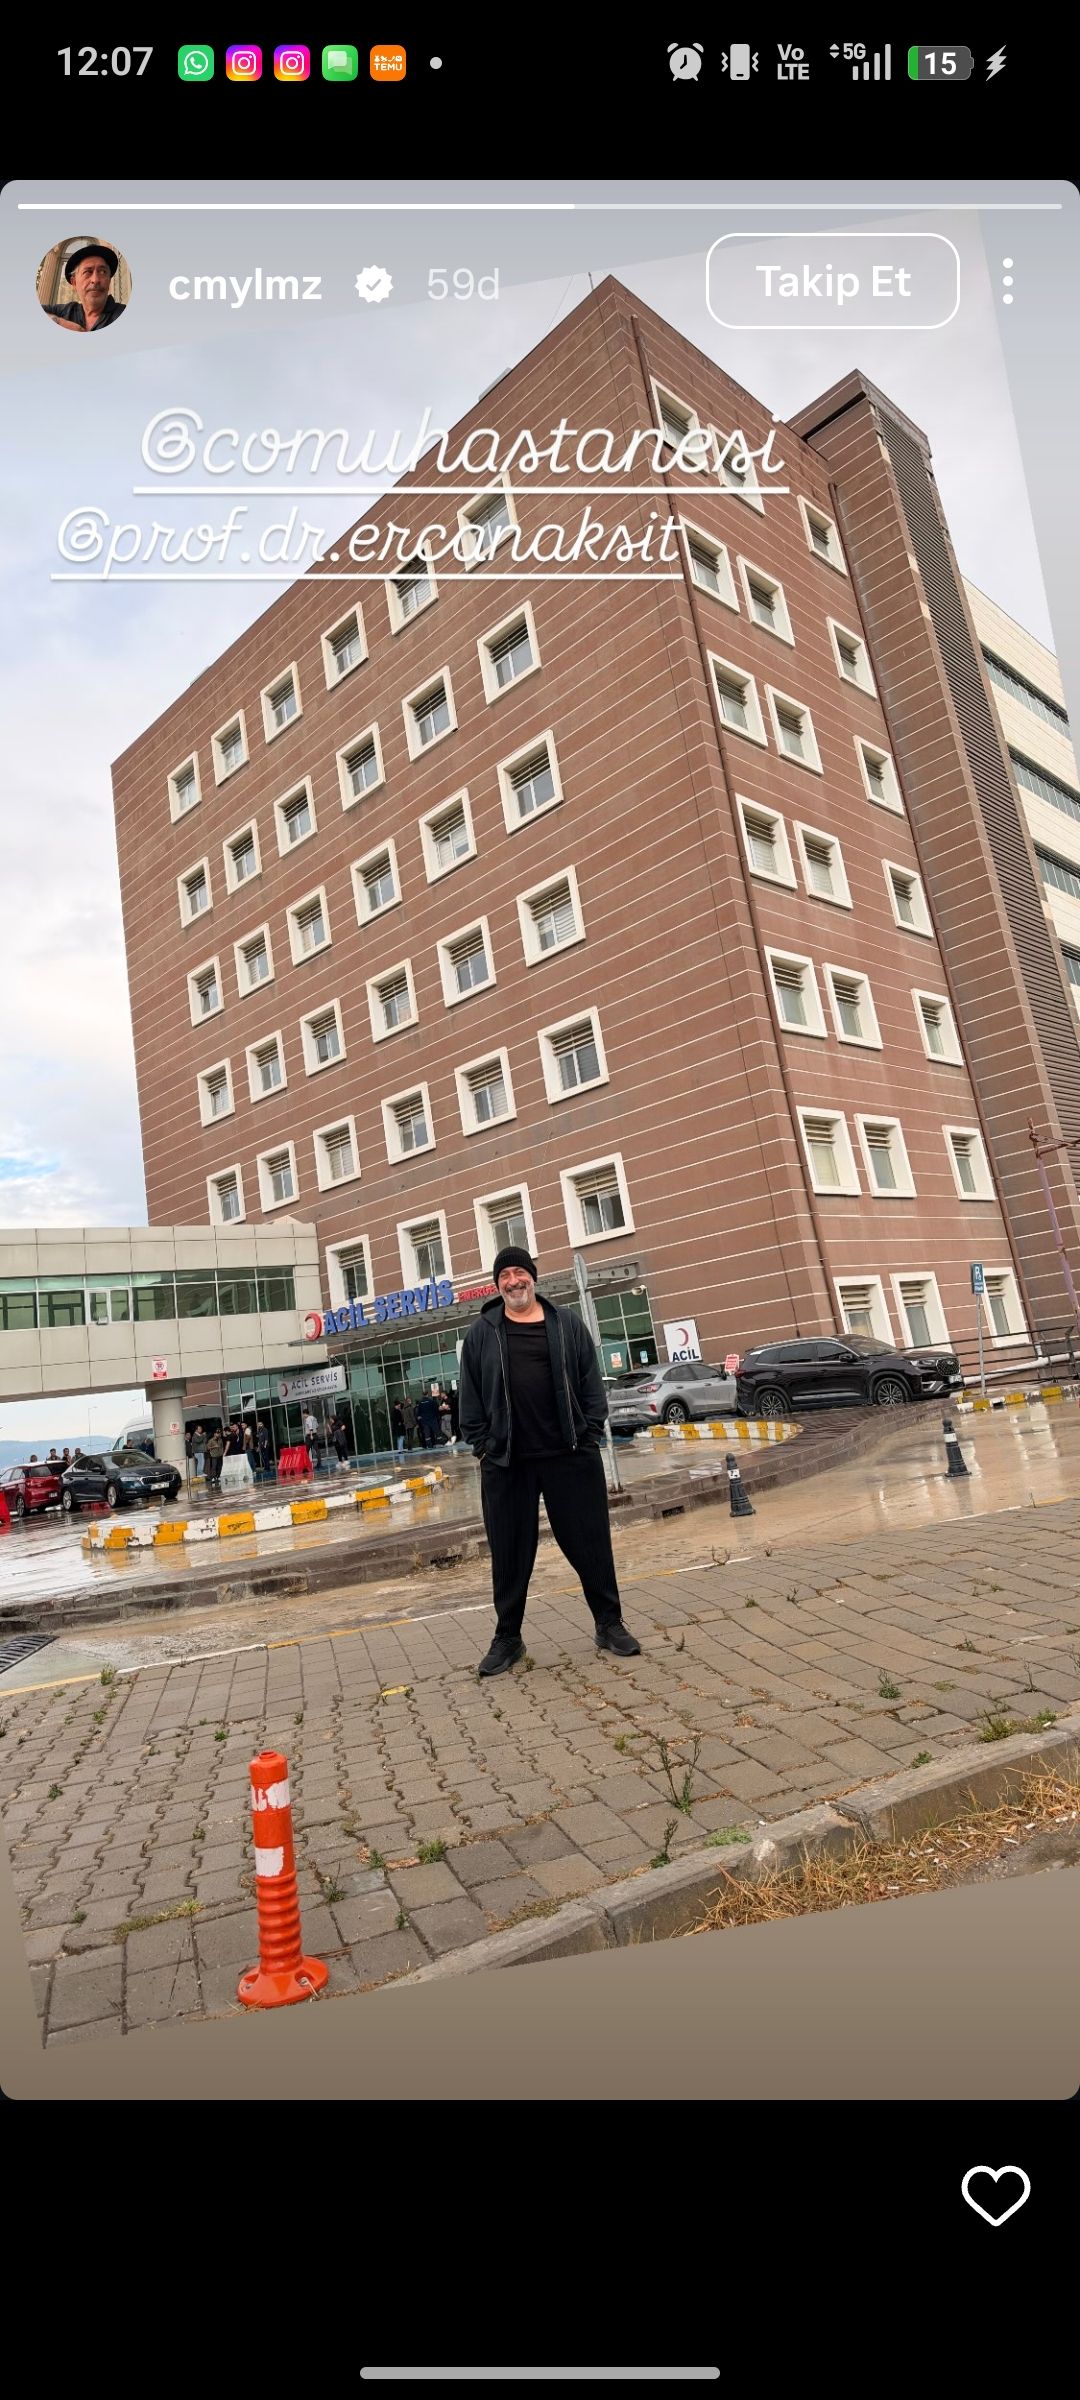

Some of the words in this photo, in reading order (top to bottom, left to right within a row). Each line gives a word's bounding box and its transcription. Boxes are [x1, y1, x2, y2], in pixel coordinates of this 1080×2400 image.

[458, 1283, 497, 1303] EMERGE
[323, 1298, 369, 1336] ACİL
[374, 1276, 455, 1324] SERVİS
[671, 1346, 700, 1363] ACİL
